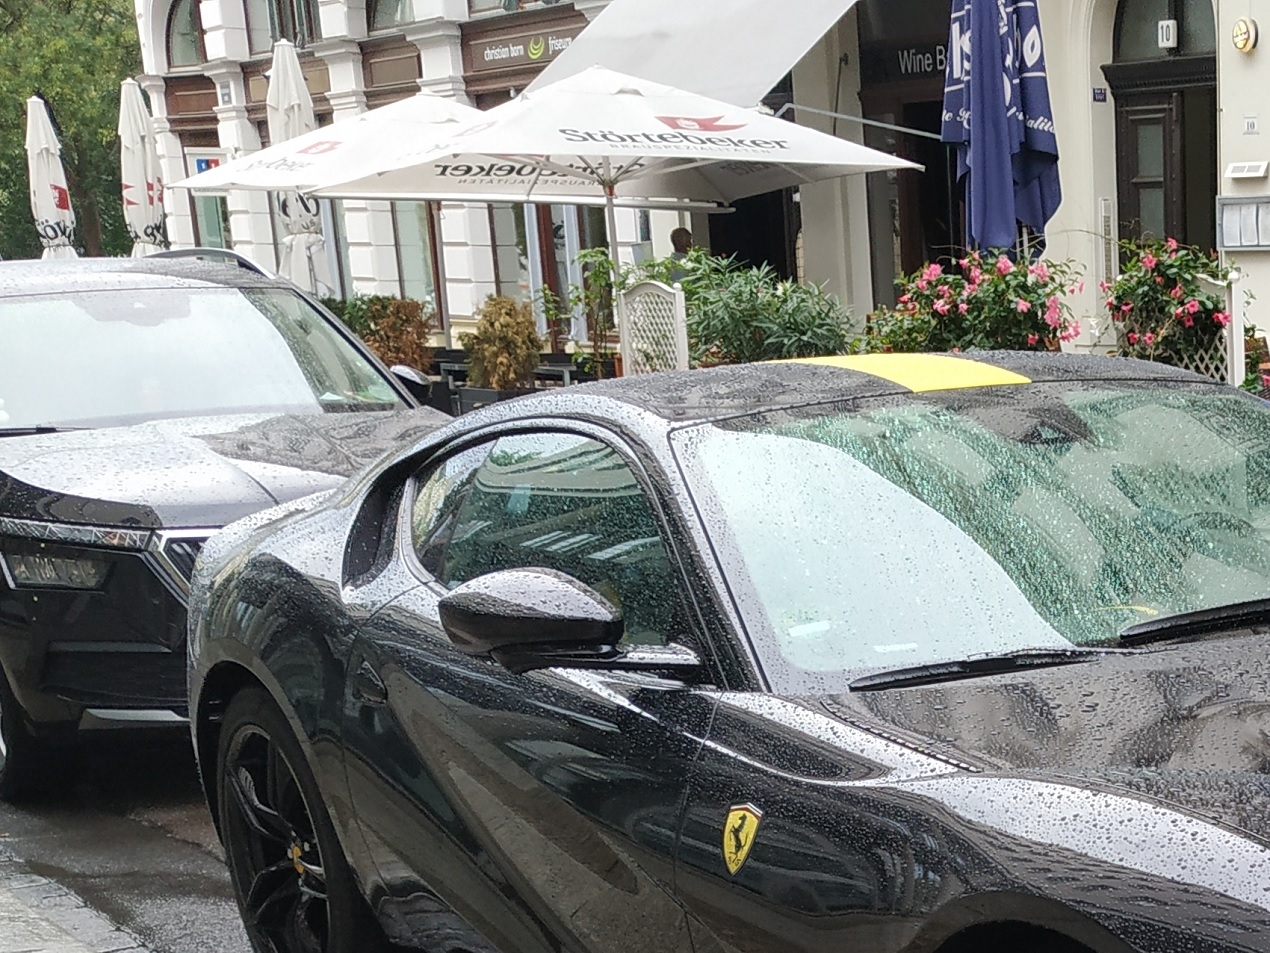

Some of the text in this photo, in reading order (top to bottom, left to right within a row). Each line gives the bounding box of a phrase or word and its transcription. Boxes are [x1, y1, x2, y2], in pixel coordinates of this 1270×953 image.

[1160, 24, 1171, 43] 10
[898, 49, 933, 74] Wine
[558, 128, 790, 150] Störtebeker
